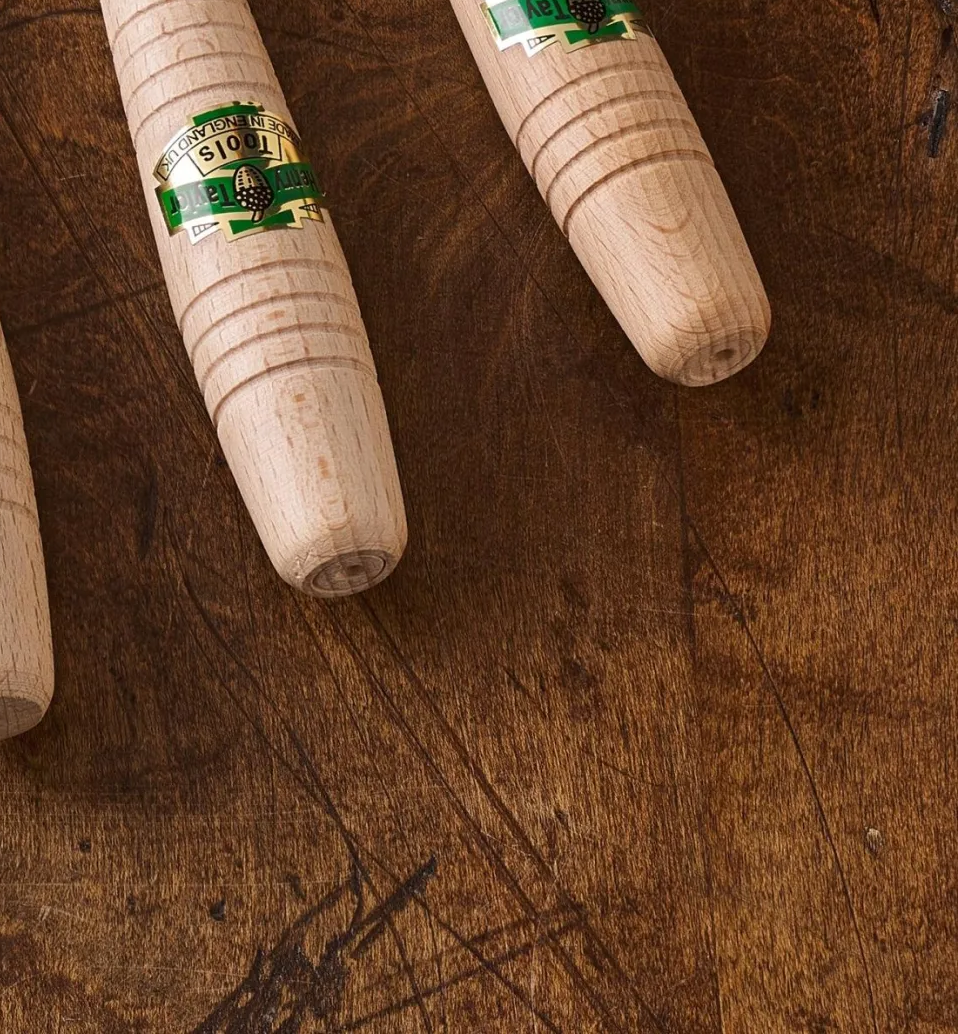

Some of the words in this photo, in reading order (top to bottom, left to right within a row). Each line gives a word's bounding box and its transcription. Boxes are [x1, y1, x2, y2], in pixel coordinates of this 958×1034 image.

[178, 114, 247, 151] ENGLAND
[249, 115, 265, 129] IN
[199, 133, 273, 162] Tools
[162, 154, 180, 172] UK
[168, 183, 237, 215] Taylor
